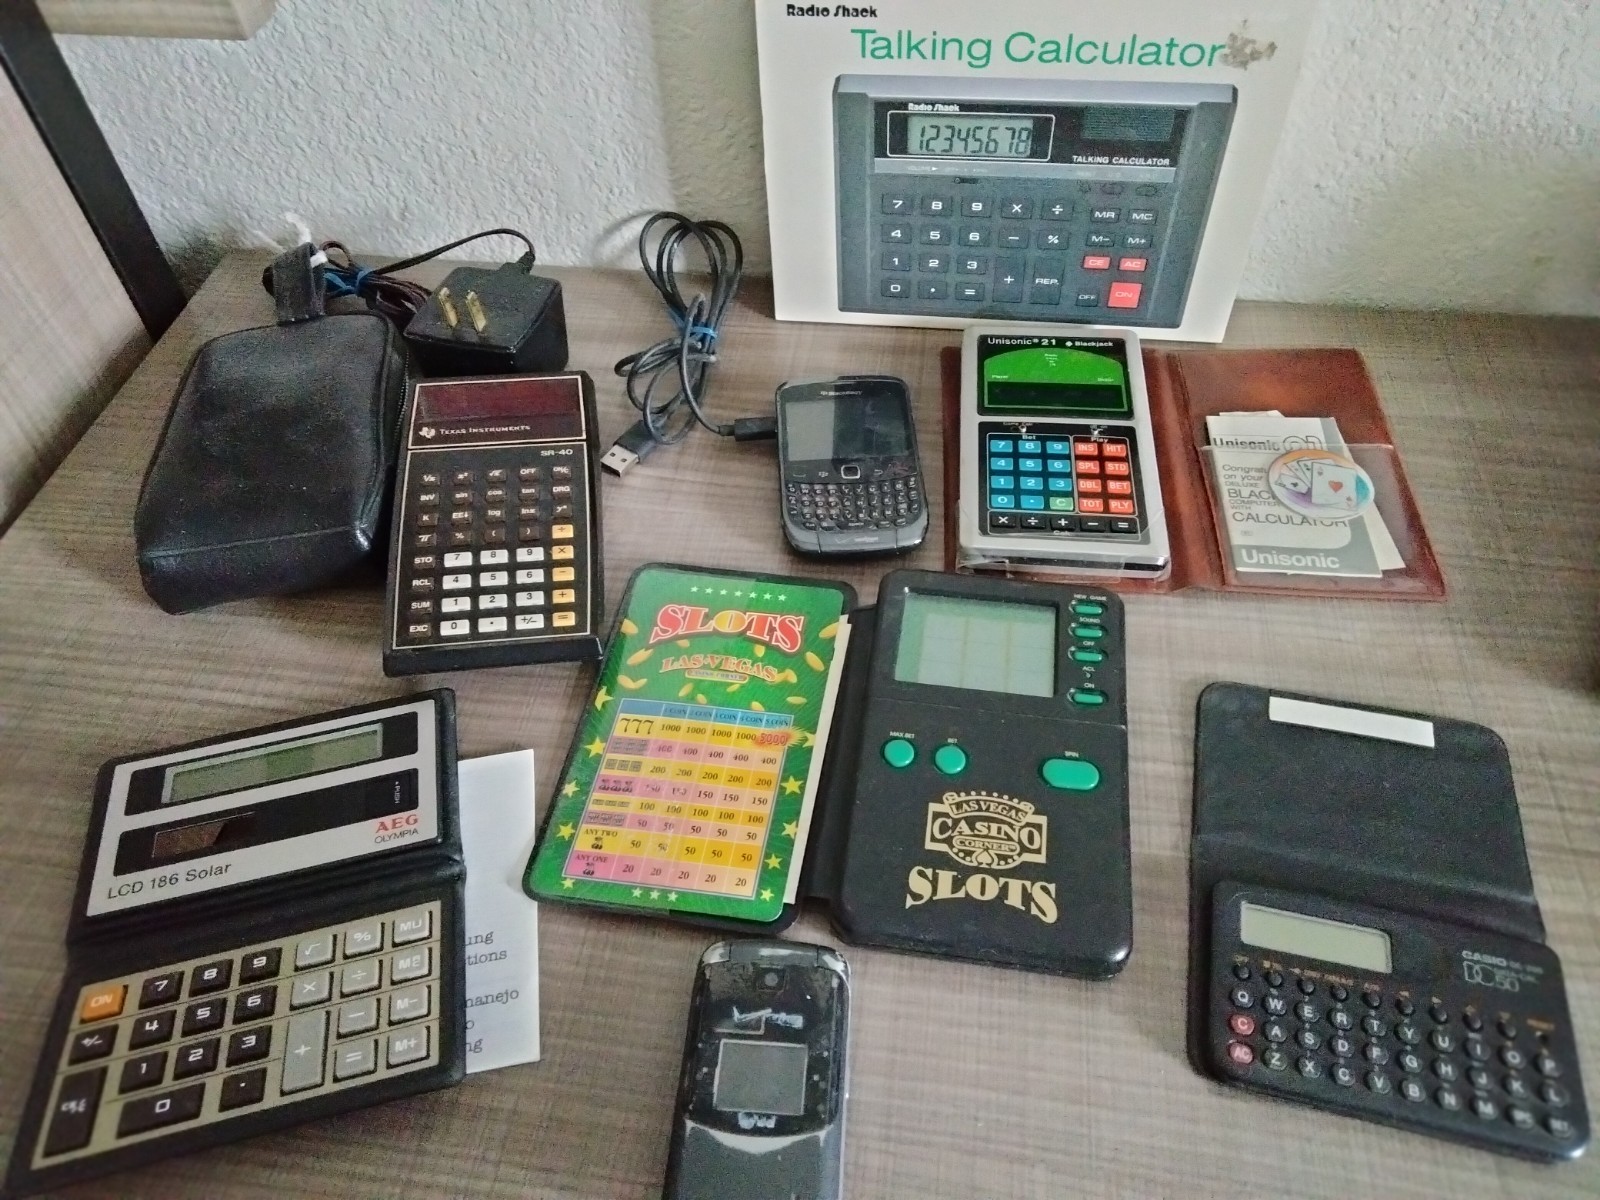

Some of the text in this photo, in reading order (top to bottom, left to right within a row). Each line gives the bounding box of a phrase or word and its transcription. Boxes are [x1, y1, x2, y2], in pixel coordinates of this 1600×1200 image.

[787, 4, 877, 17] Radio Shack
[850, 28, 1227, 68] Talking Calculator
[908, 102, 932, 111] Radio
[919, 125, 1031, 155] 12345678
[1072, 155, 1170, 166] TALKING CALCULATOR
[1094, 211, 1115, 219] MR
[1132, 212, 1153, 221] MC
[1088, 258, 1105, 267] CE
[1124, 260, 1141, 269] AC
[1035, 277, 1059, 286] REP.
[1115, 290, 1133, 298] ON
[1041, 338, 1056, 346] 21
[1213, 438, 1280, 452] Unisonic
[1110, 482, 1128, 490] BET
[1241, 548, 1340, 569] Unisonic
[649, 604, 805, 653] SLOTS
[620, 717, 654, 735] 777
[661, 724, 681, 733] 1000
[686, 726, 706, 735] 1000
[711, 729, 732, 738] 1000
[736, 732, 757, 741] 1000
[708, 750, 777, 765] 400 400 400
[650, 766, 772, 787] 200 200 200 200
[698, 790, 768, 805] 150 150 150
[692, 808, 764, 824] 100 100 100
[950, 801, 1026, 822] LAS VEGAS
[375, 814, 419, 834] AEG
[374, 828, 419, 844] OLYMPIA
[691, 826, 757, 841] 50 50 50
[932, 817, 1041, 850] CASINO
[575, 854, 592, 862] ANY
[685, 847, 752, 862] 50 50 50
[107, 862, 232, 899] LCD 186 Solar
[623, 864, 747, 886] 20 20 20 20
[905, 866, 1058, 924] SLOTS
[400, 919, 423, 931] MU
[253, 956, 266, 968] 9
[204, 969, 217, 980] 8
[155, 980, 169, 992] 7
[90, 994, 113, 1007] ON
[247, 995, 261, 1006] 6
[1238, 992, 1249, 1002] Q
[1269, 998, 1282, 1010] W
[196, 1007, 210, 1019] 5
[1304, 1006, 1312, 1016] E
[145, 1021, 158, 1032] 4
[1238, 1020, 1248, 1030] C
[1272, 1026, 1281, 1037] A
[241, 1035, 256, 1047] 3
[395, 1037, 418, 1052] M+
[188, 1049, 203, 1061] 2
[140, 1063, 147, 1074] 1
